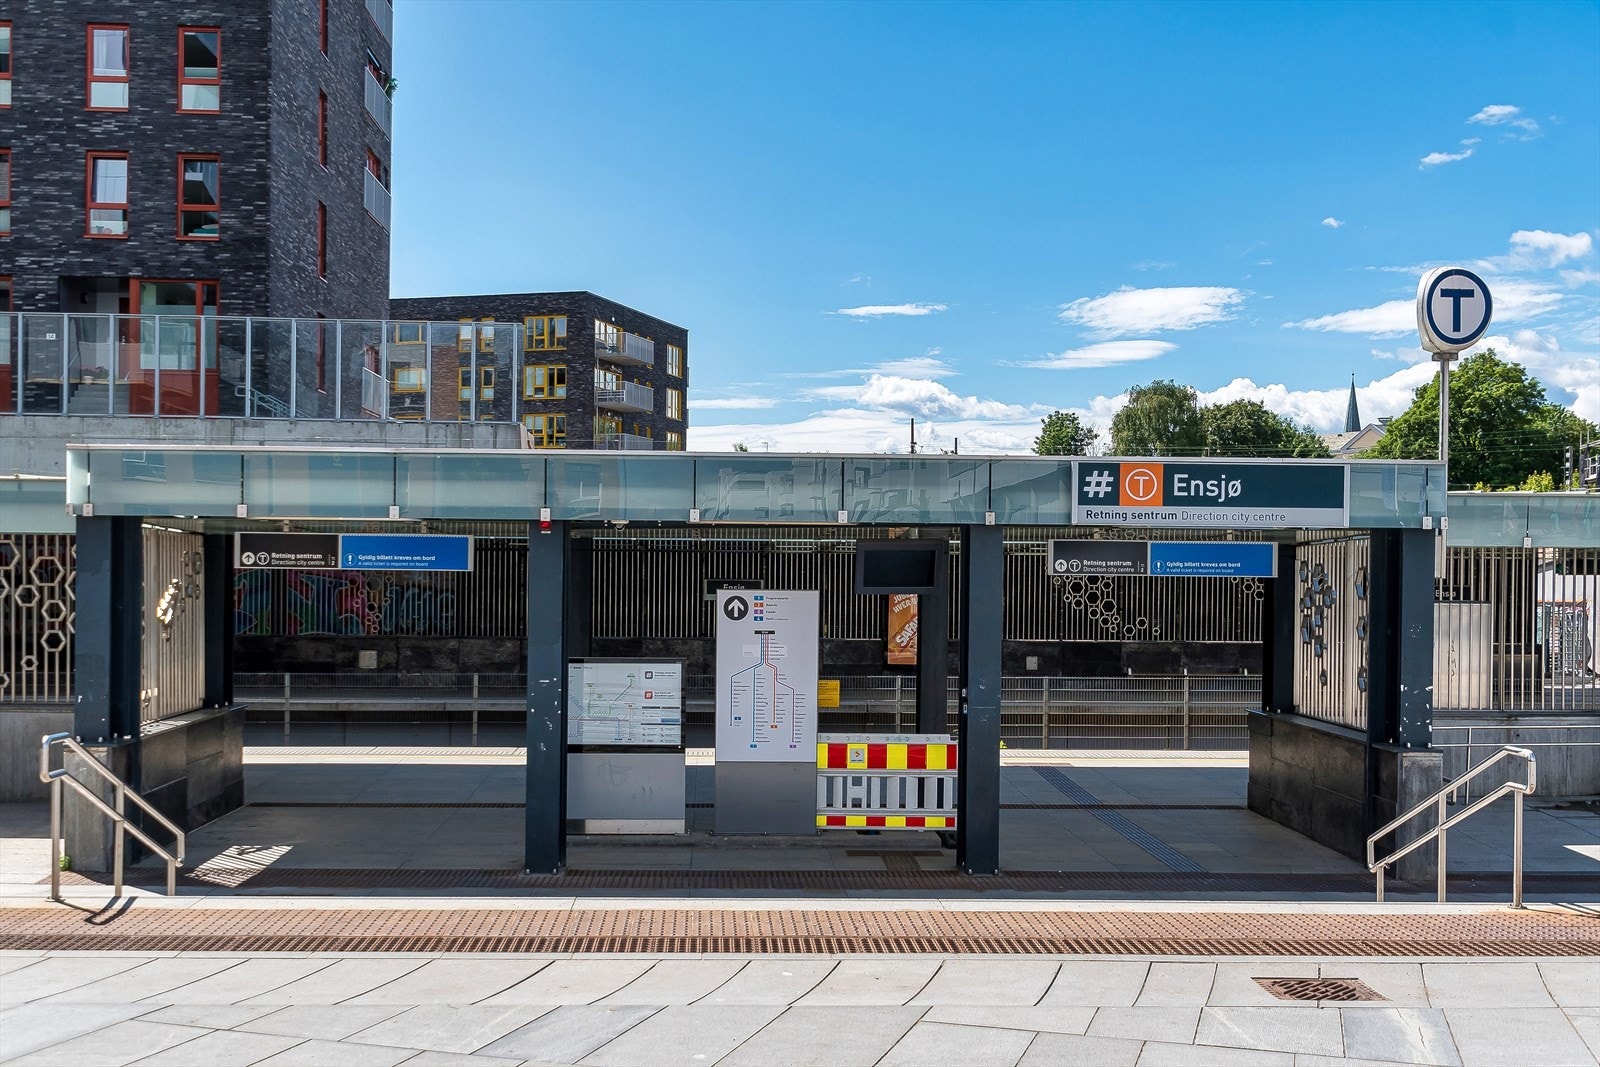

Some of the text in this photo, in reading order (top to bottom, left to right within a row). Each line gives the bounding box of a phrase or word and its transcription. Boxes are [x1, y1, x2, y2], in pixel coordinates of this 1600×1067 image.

[1440, 288, 1474, 332] T
[1173, 473, 1242, 502] Ensjø
[1086, 510, 1286, 523] Retning sentrum Direction city centre
[896, 616, 918, 647] SAFA
